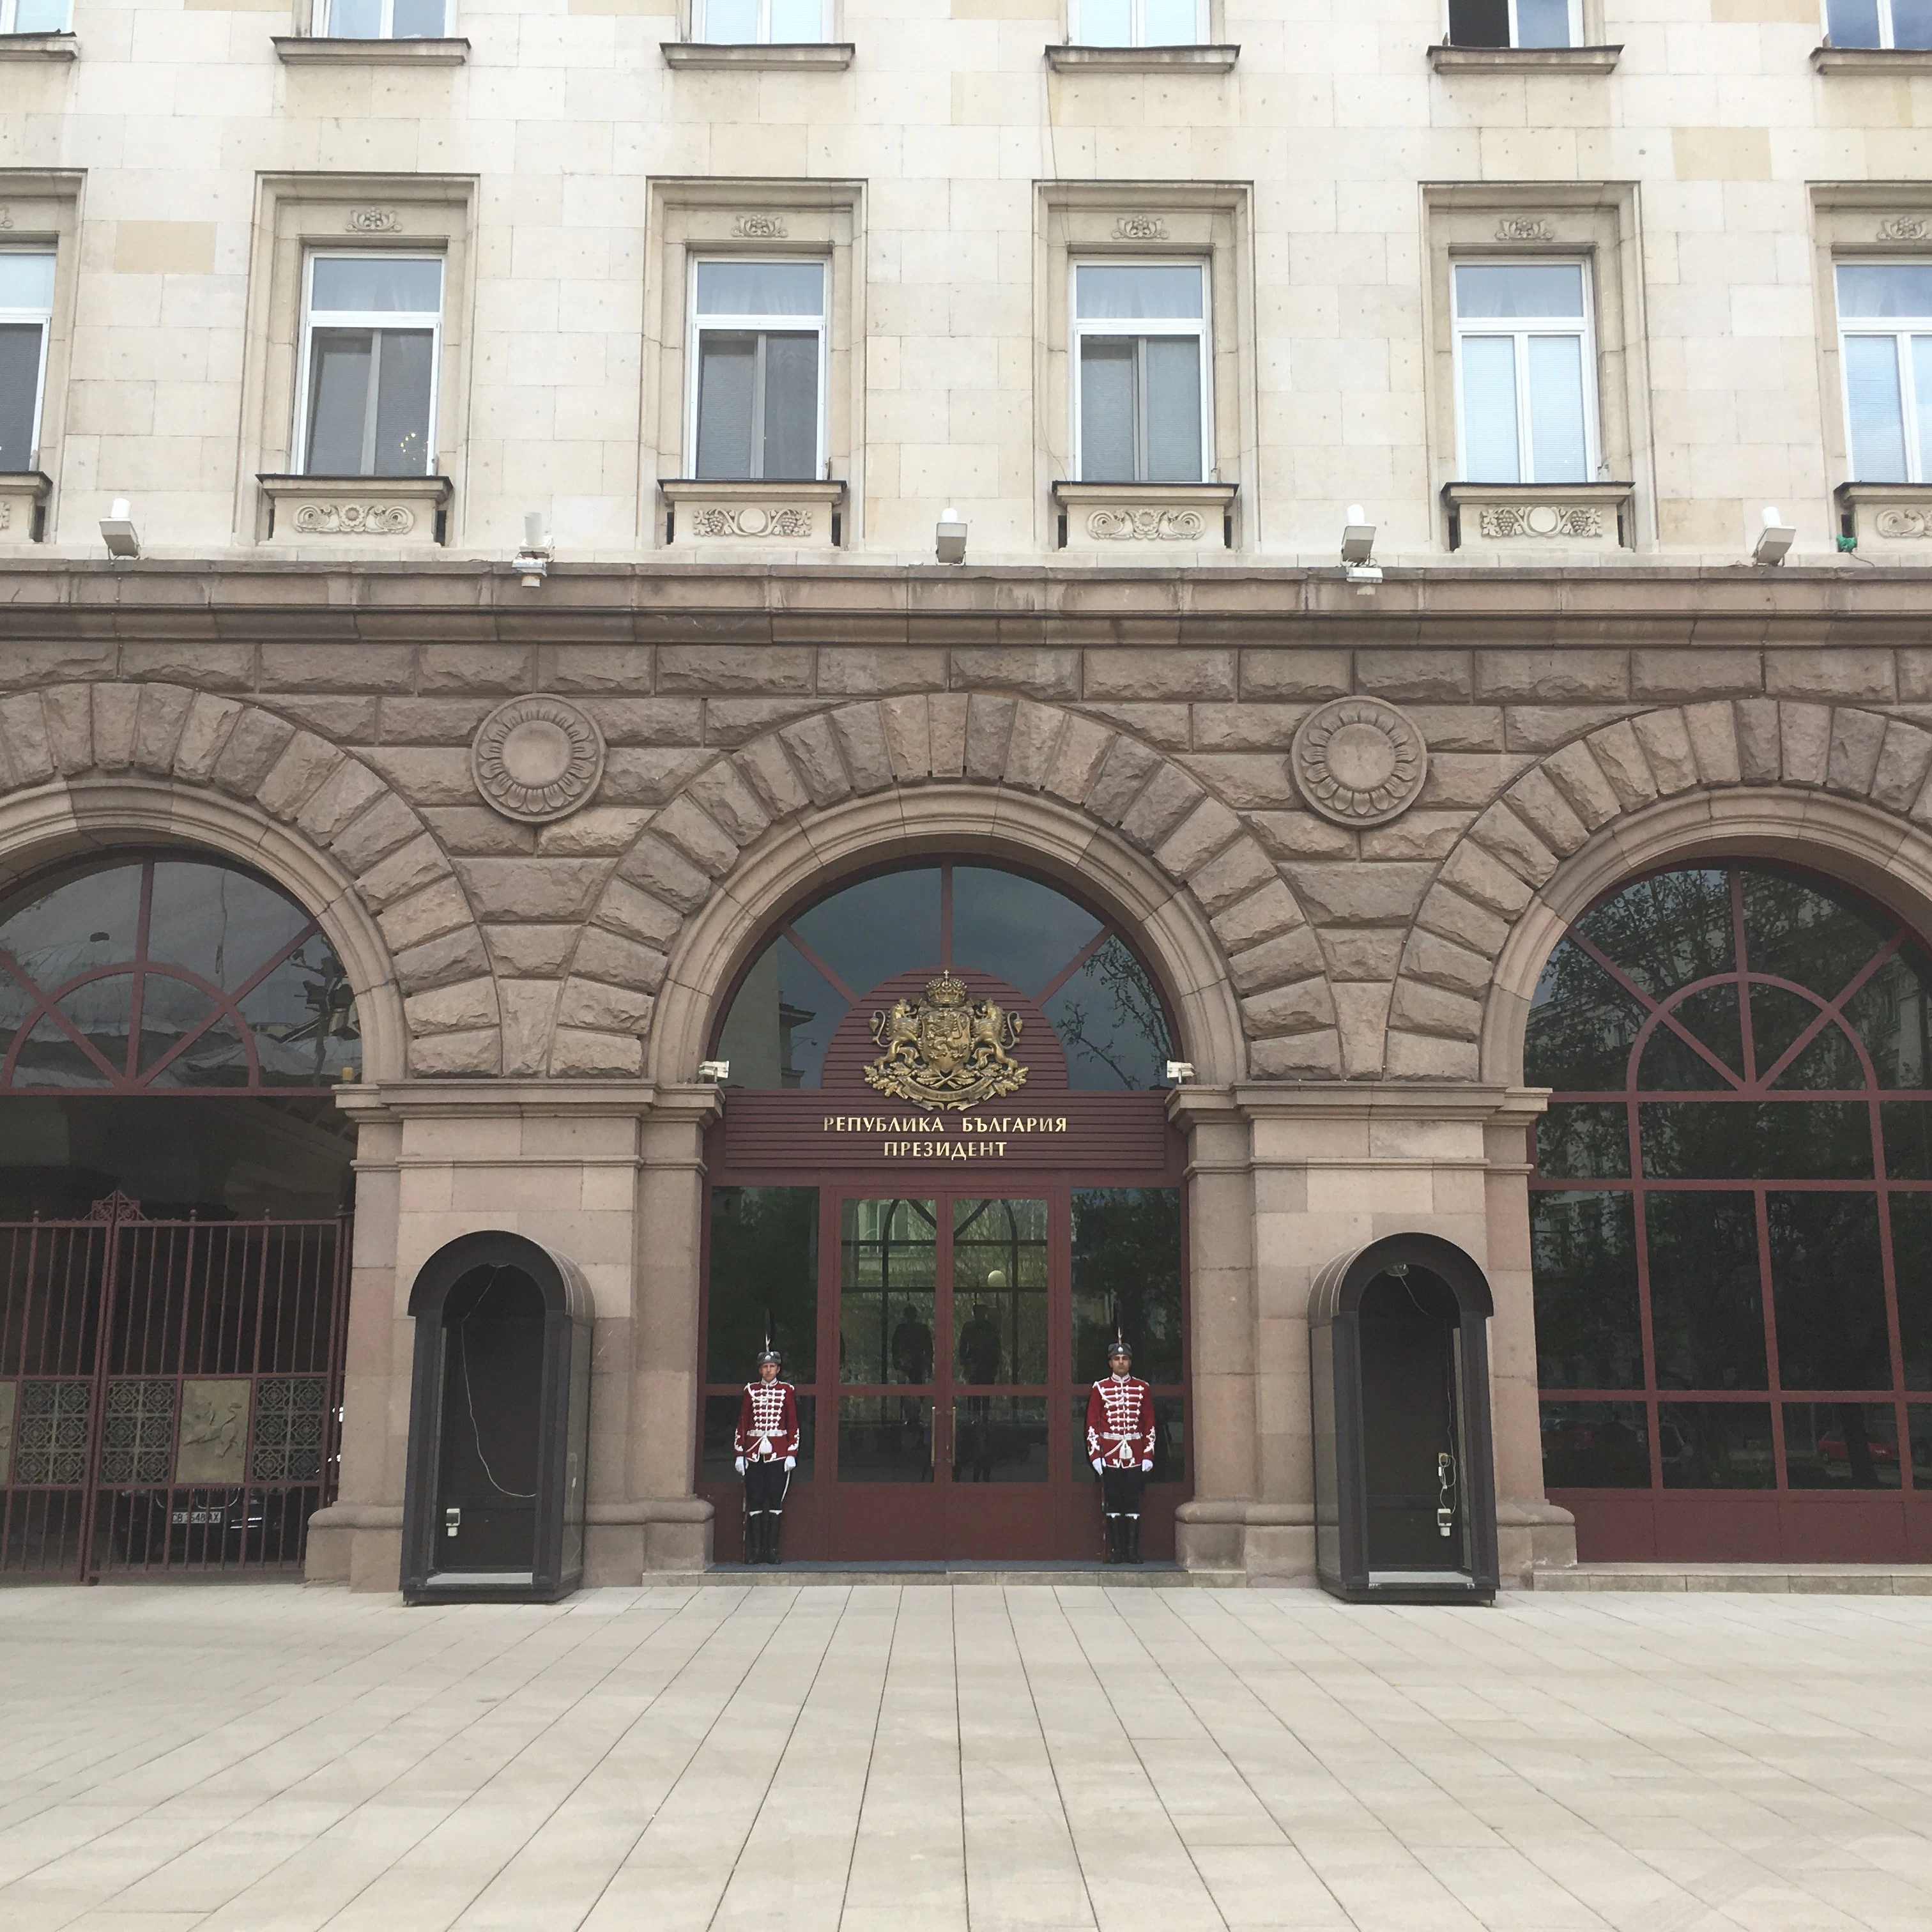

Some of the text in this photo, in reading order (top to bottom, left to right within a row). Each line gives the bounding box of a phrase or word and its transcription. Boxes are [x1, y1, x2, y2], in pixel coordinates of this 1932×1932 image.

[824, 1117, 1067, 1132] РЕПУБЛИКА БЪЛГАРИЯ
[884, 1142, 1008, 1161] ПРЕЗИДЕНТ
